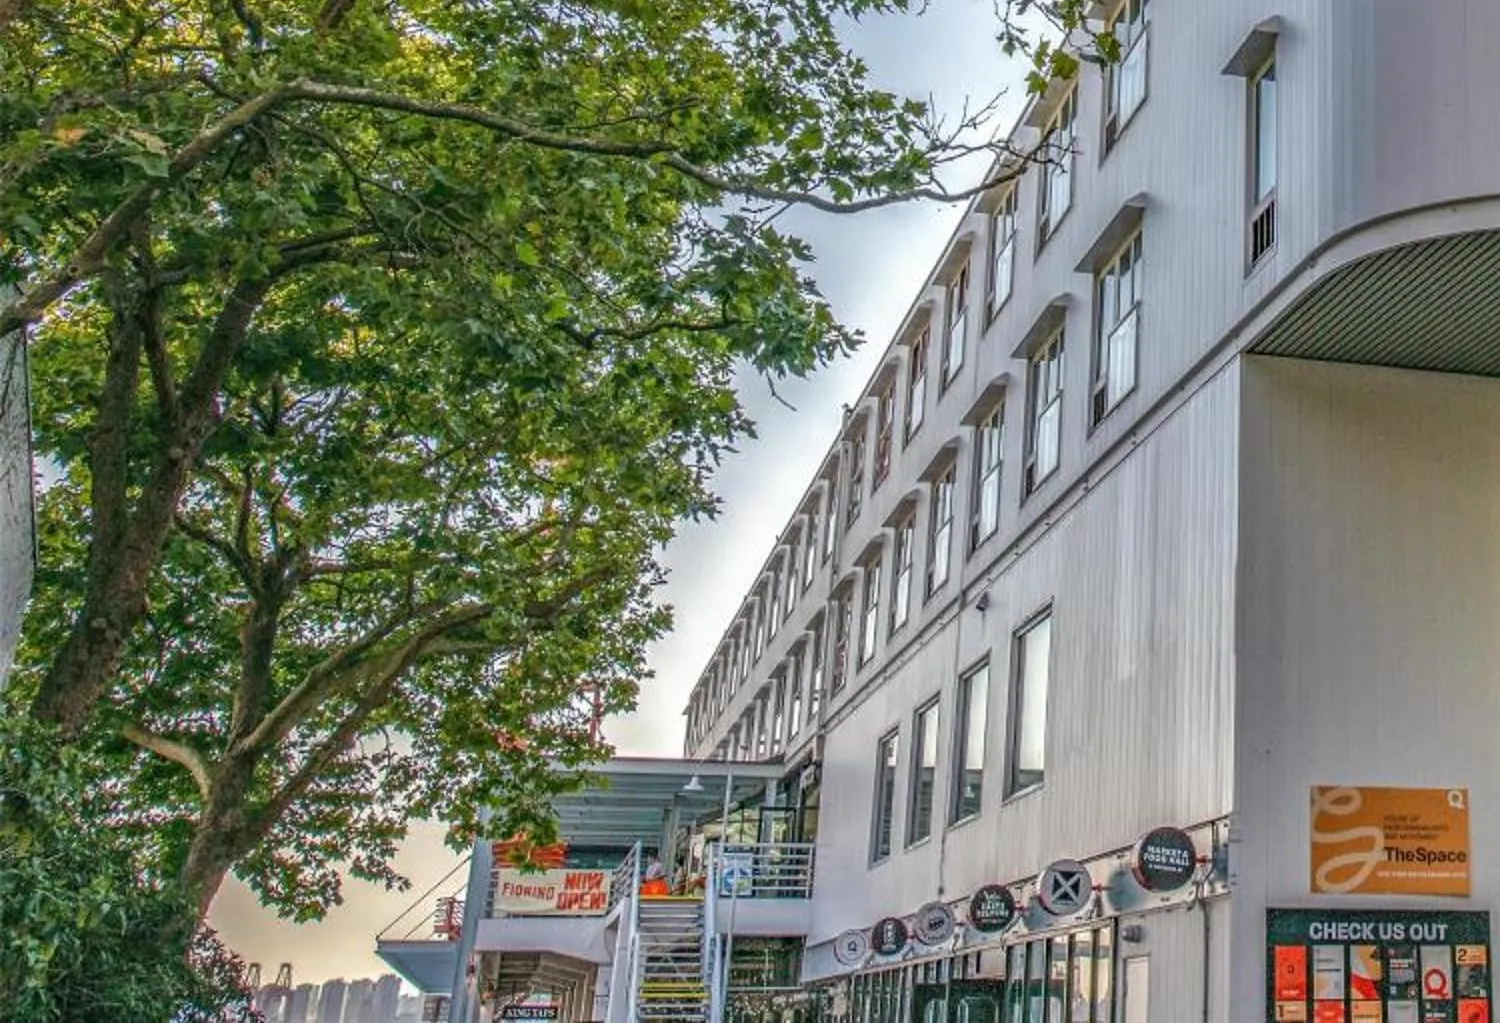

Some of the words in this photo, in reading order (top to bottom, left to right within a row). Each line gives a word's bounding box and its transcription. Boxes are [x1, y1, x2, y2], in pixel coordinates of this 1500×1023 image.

[1383, 846, 1467, 866] TheSpace
[563, 872, 605, 891] NOW
[501, 882, 556, 902] FIORINO
[1309, 921, 1375, 940] CHECK
[1379, 922, 1405, 940] US
[1409, 923, 1449, 941] OUT
